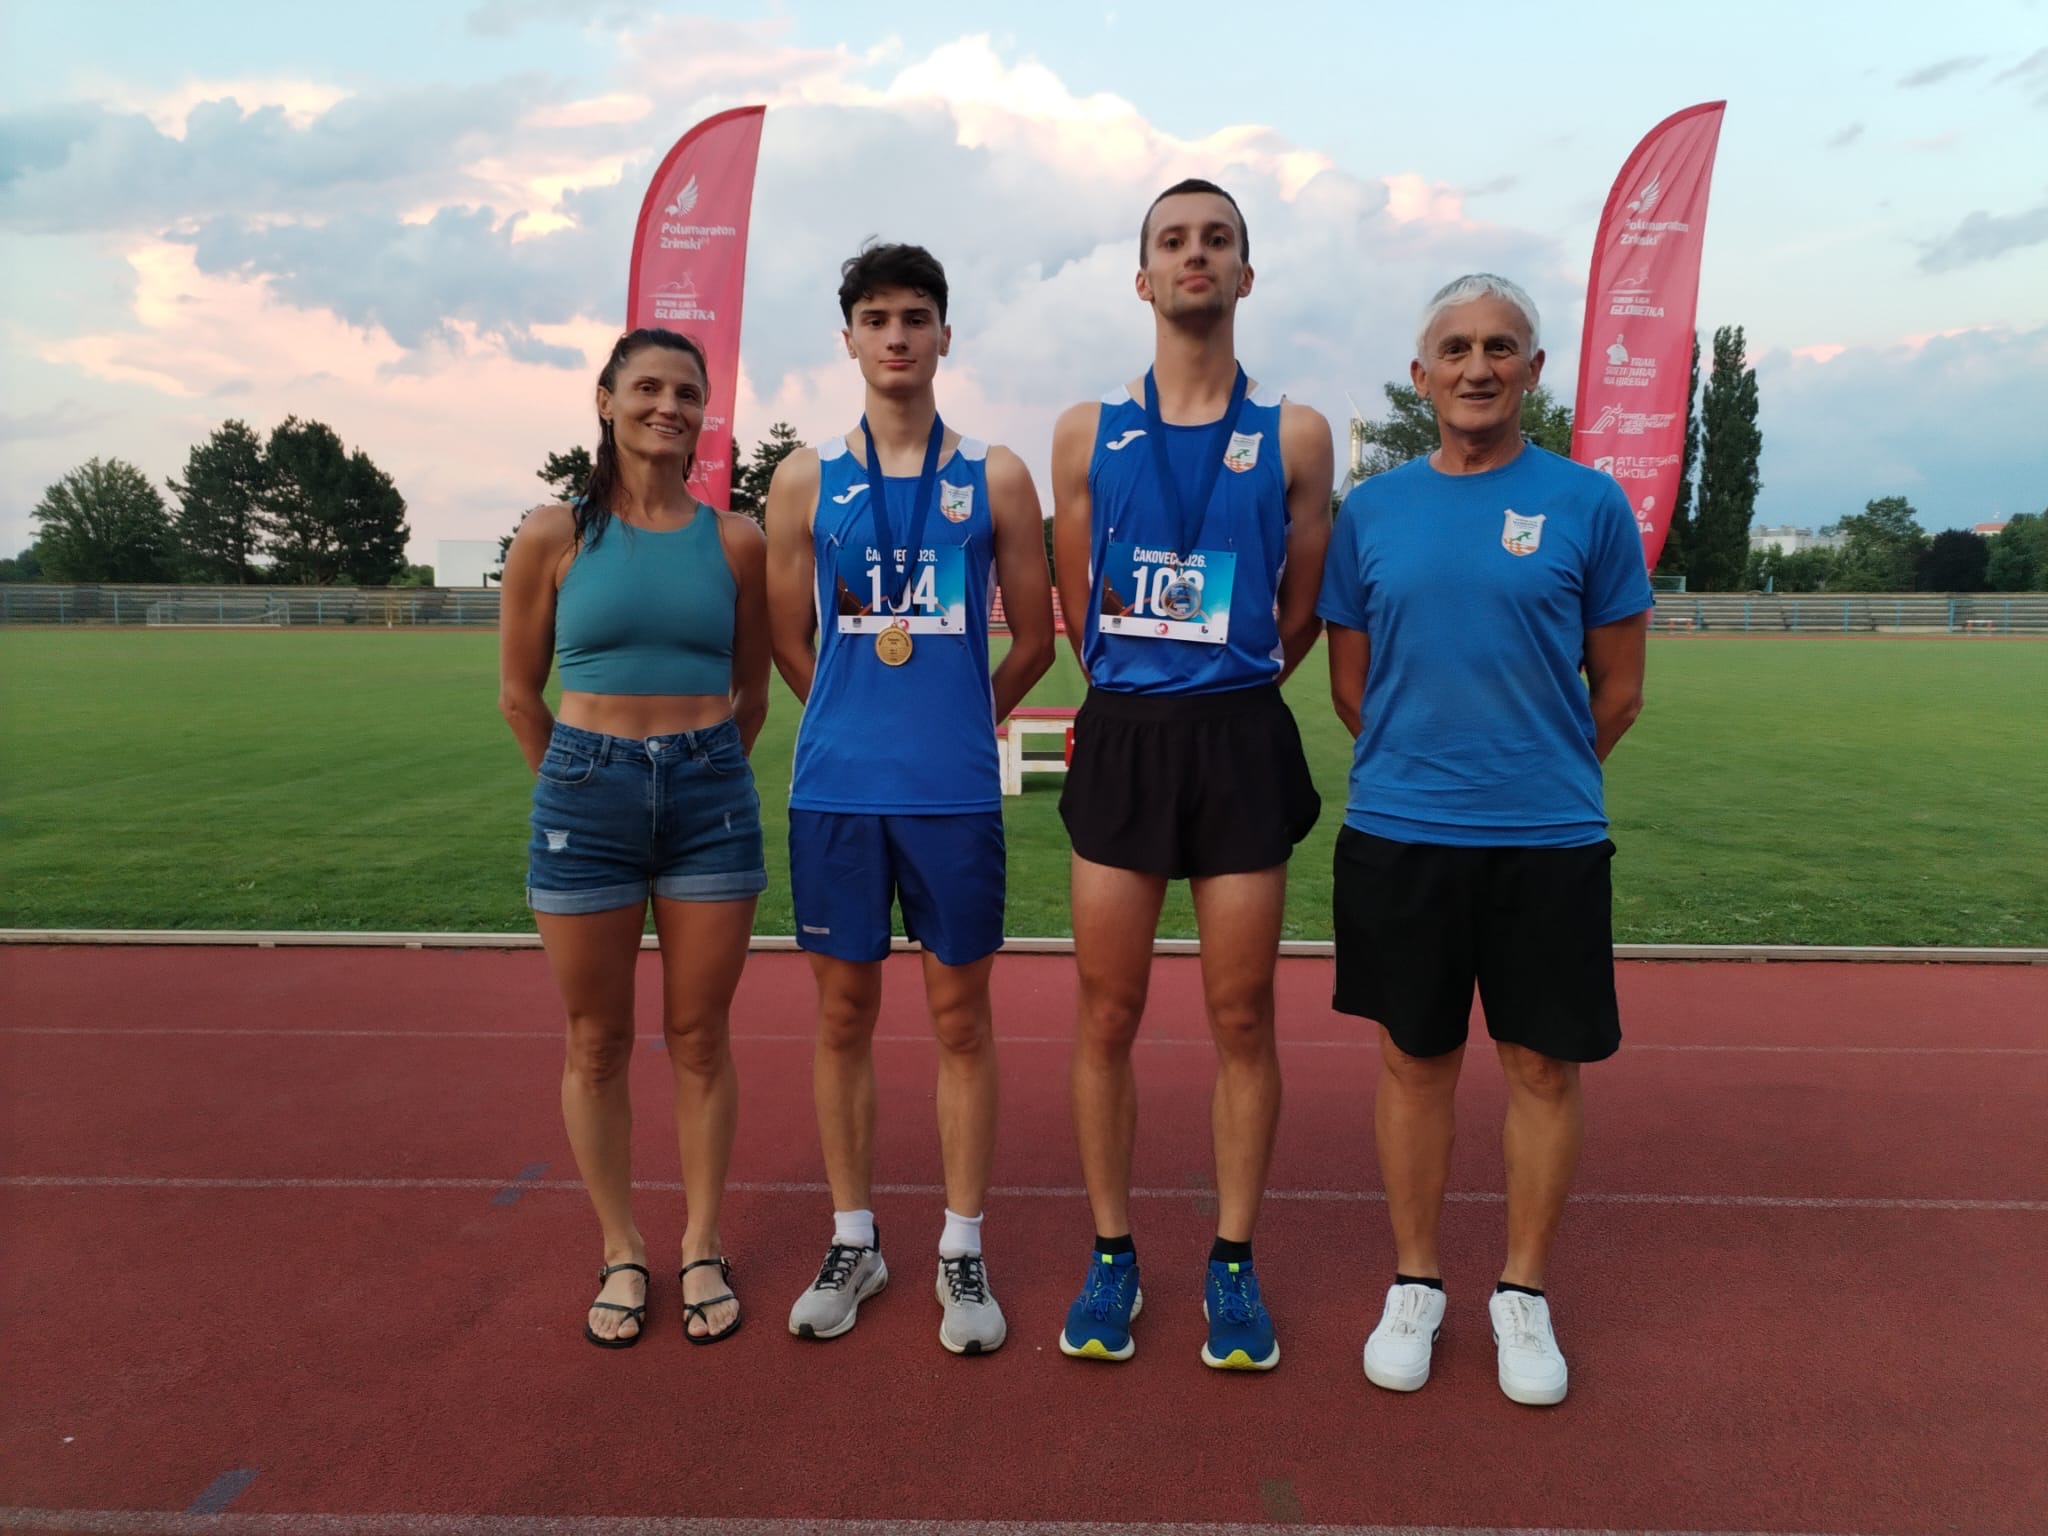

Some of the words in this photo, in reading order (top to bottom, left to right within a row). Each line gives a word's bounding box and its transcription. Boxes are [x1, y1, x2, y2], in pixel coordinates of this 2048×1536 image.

[661, 222, 736, 236] Polumaraton
[660, 237, 701, 250] Zrinski
[654, 308, 716, 321] GLOBETKA
[1609, 304, 1665, 317] GLOBETKA
[1616, 455, 1679, 467] ATLETSKA
[1133, 546, 1178, 566] ČAKOVEC
